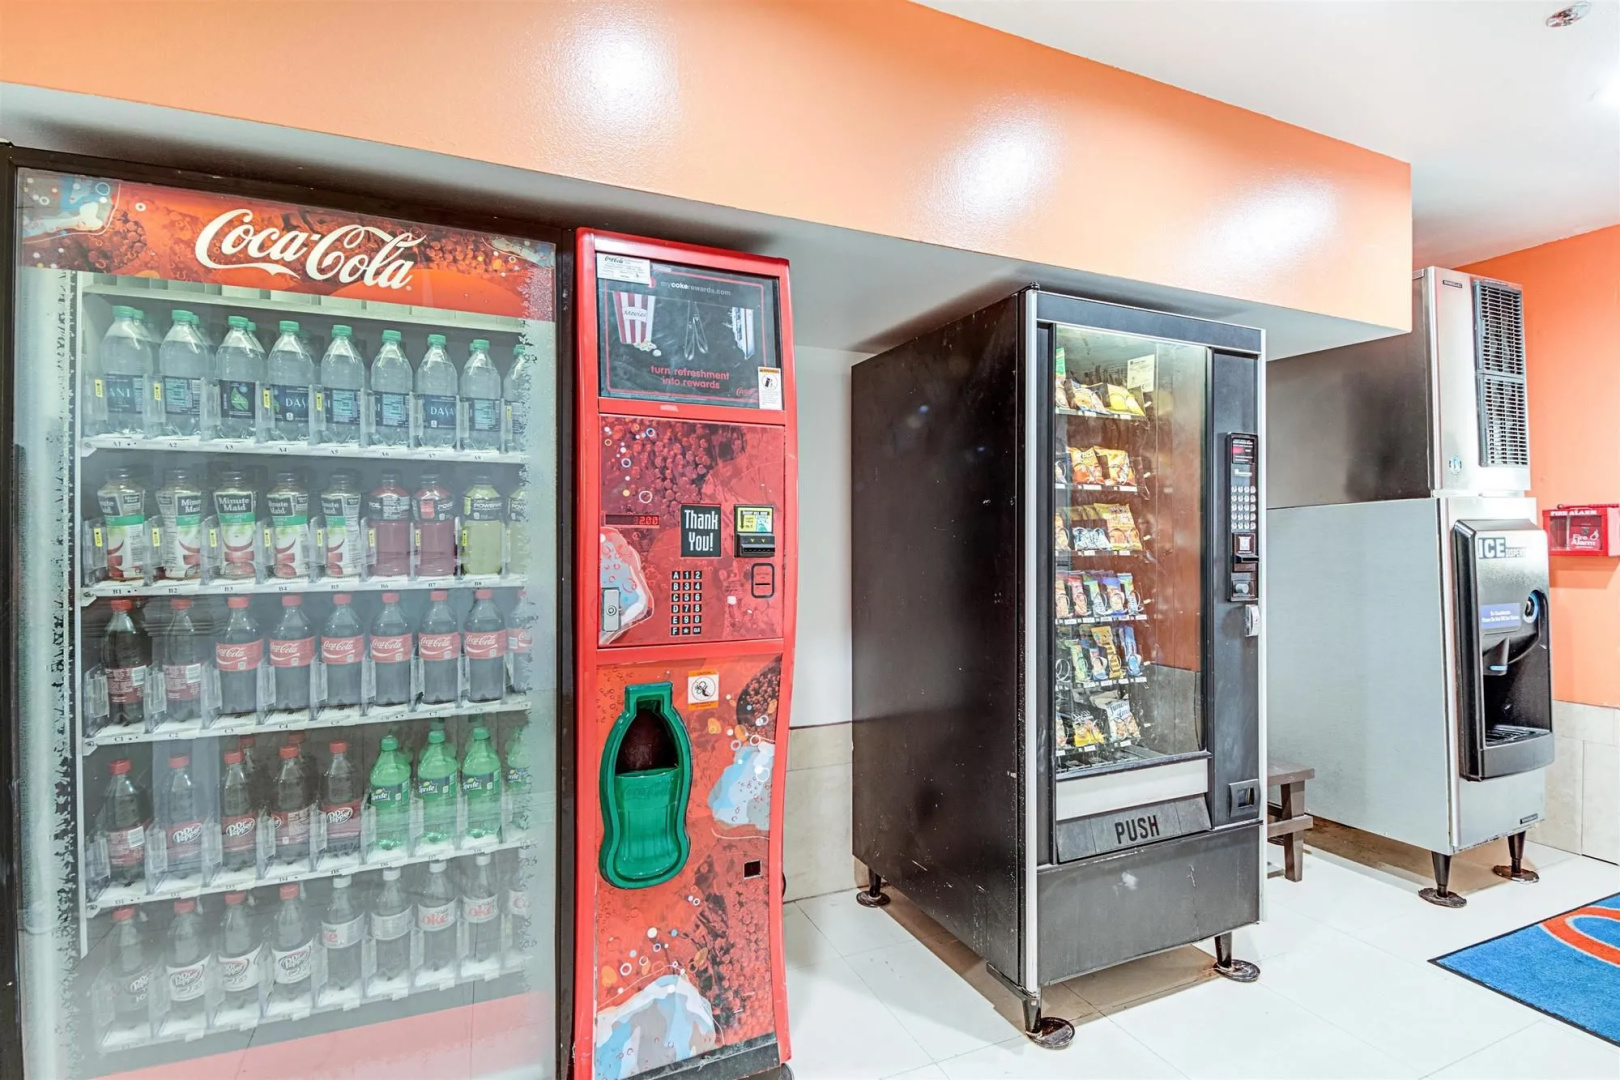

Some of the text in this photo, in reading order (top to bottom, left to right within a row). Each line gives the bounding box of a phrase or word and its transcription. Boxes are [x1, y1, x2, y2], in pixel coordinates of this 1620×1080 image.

[195, 208, 426, 291] Coca-Cola
[661, 281, 731, 297] mycokerewards.com
[651, 366, 730, 380] turn refreshment
[661, 377, 720, 389] into rewards
[109, 388, 131, 398] ANI
[285, 397, 307, 409] DAS
[430, 406, 455, 418] DASA
[181, 499, 202, 507] Minu
[223, 504, 247, 512] Maid
[185, 505, 202, 513] Mai
[684, 509, 719, 530] Thank
[688, 531, 714, 552] You!
[1570, 539, 1596, 547] Alarm
[1478, 538, 1506, 558] ICE
[673, 582, 701, 590] B 3 4
[673, 593, 701, 601] C 5 6
[673, 627, 679, 635] F
[324, 640, 354, 651] Coca-Cola
[372, 638, 403, 649] Coca-Cola
[421, 636, 452, 647] Coca-Cola
[467, 635, 498, 646] Coca-Cola
[418, 785, 435, 794] Sprite
[371, 792, 388, 801] Sprite
[329, 810, 350, 823] Pepper
[176, 826, 201, 843] Pepper
[229, 821, 252, 837] Pepper
[1114, 814, 1160, 844] PUSH
